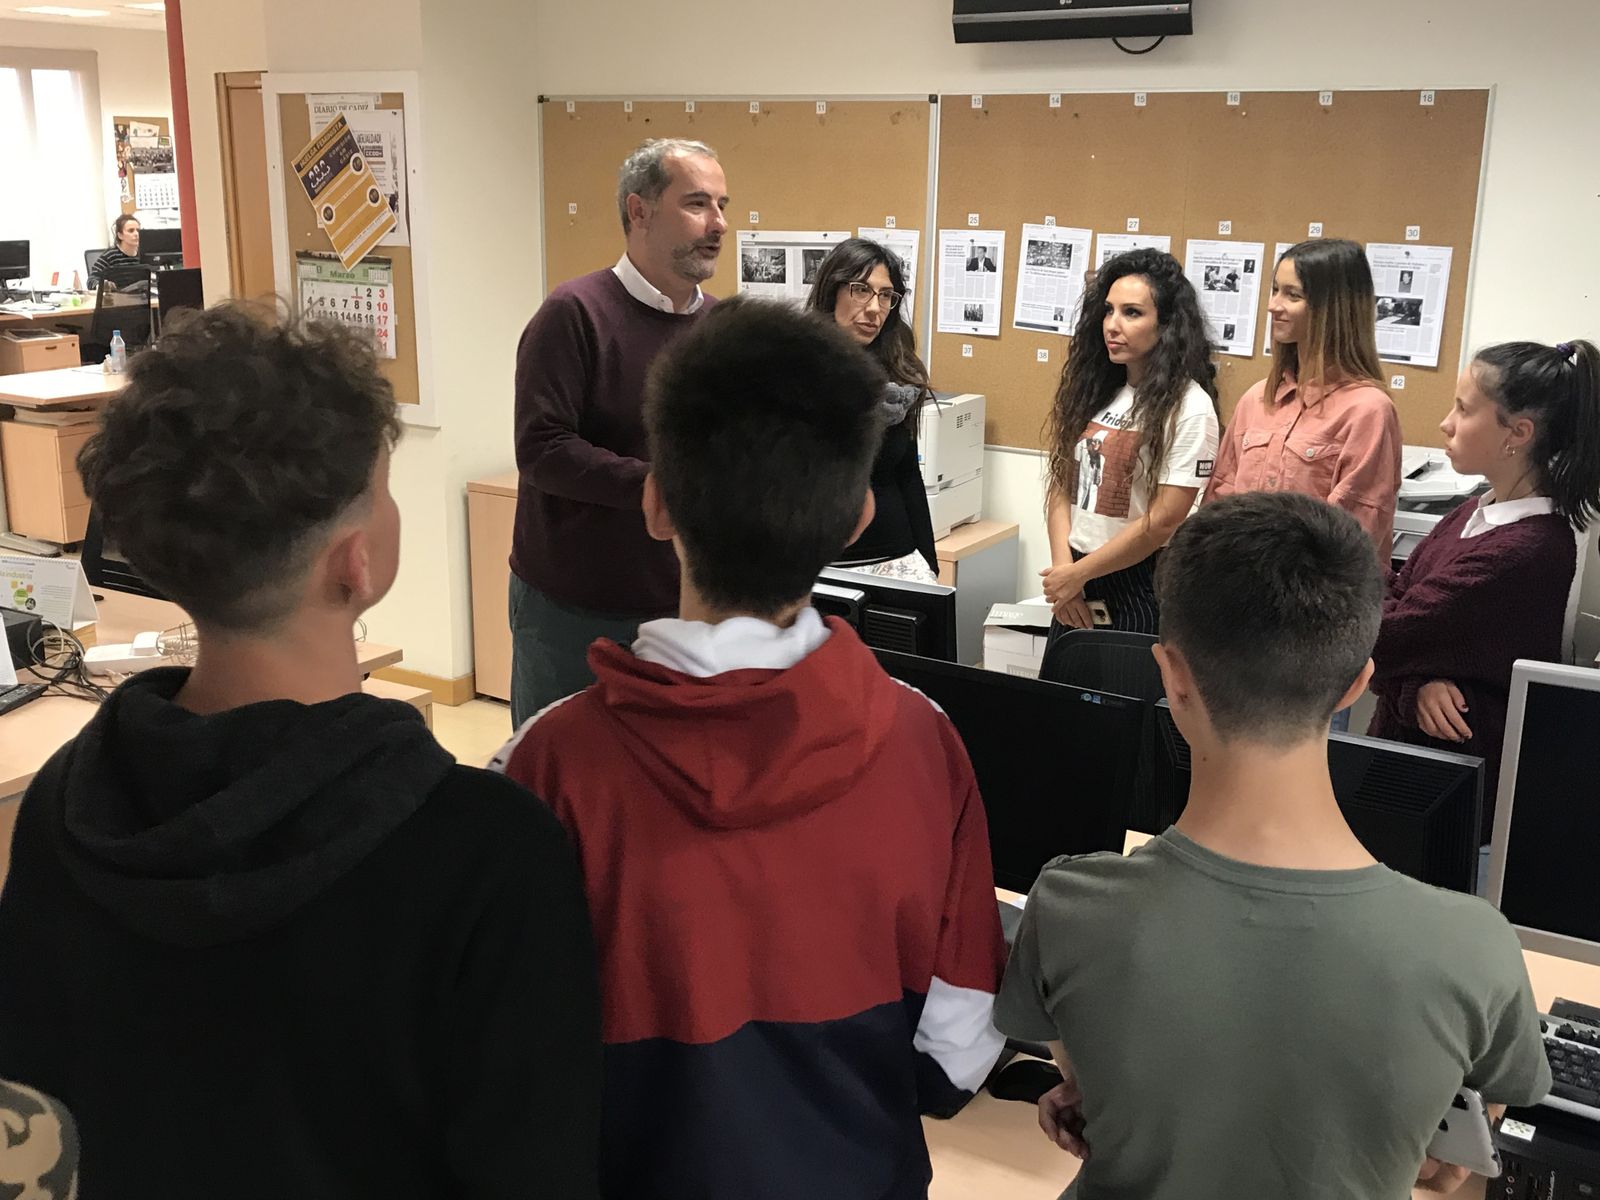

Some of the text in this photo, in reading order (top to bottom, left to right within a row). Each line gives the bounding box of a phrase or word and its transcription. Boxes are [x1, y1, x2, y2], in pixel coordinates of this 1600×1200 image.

[973, 97, 981, 105] 13
[1051, 96, 1060, 104] 14
[1136, 95, 1145, 103] 15
[1229, 94, 1238, 102] 16
[1321, 95, 1331, 103] 17
[1423, 94, 1432, 102] 18
[314, 105, 338, 114] DIARIO
[817, 104, 825, 112] 11
[750, 213, 758, 221] 22
[969, 216, 978, 224] 25
[887, 218, 895, 226] 24
[1046, 218, 1055, 226] 26
[1128, 220, 1137, 229] 27
[1220, 223, 1230, 231] 28
[1407, 229, 1418, 237] 30
[330, 270, 356, 280] Marzo
[354, 287, 385, 299] 1 2 3
[307, 296, 388, 312] 4 5 6 7 8 9 10
[329, 311, 339, 321] 13
[340, 312, 351, 321] 14
[352, 313, 362, 323] 15
[364, 314, 375, 325] 16
[377, 315, 388, 326] 17
[377, 328, 388, 339] 24
[964, 347, 972, 355] 37
[1038, 351, 1047, 360] 38
[1392, 378, 1404, 387] 42
